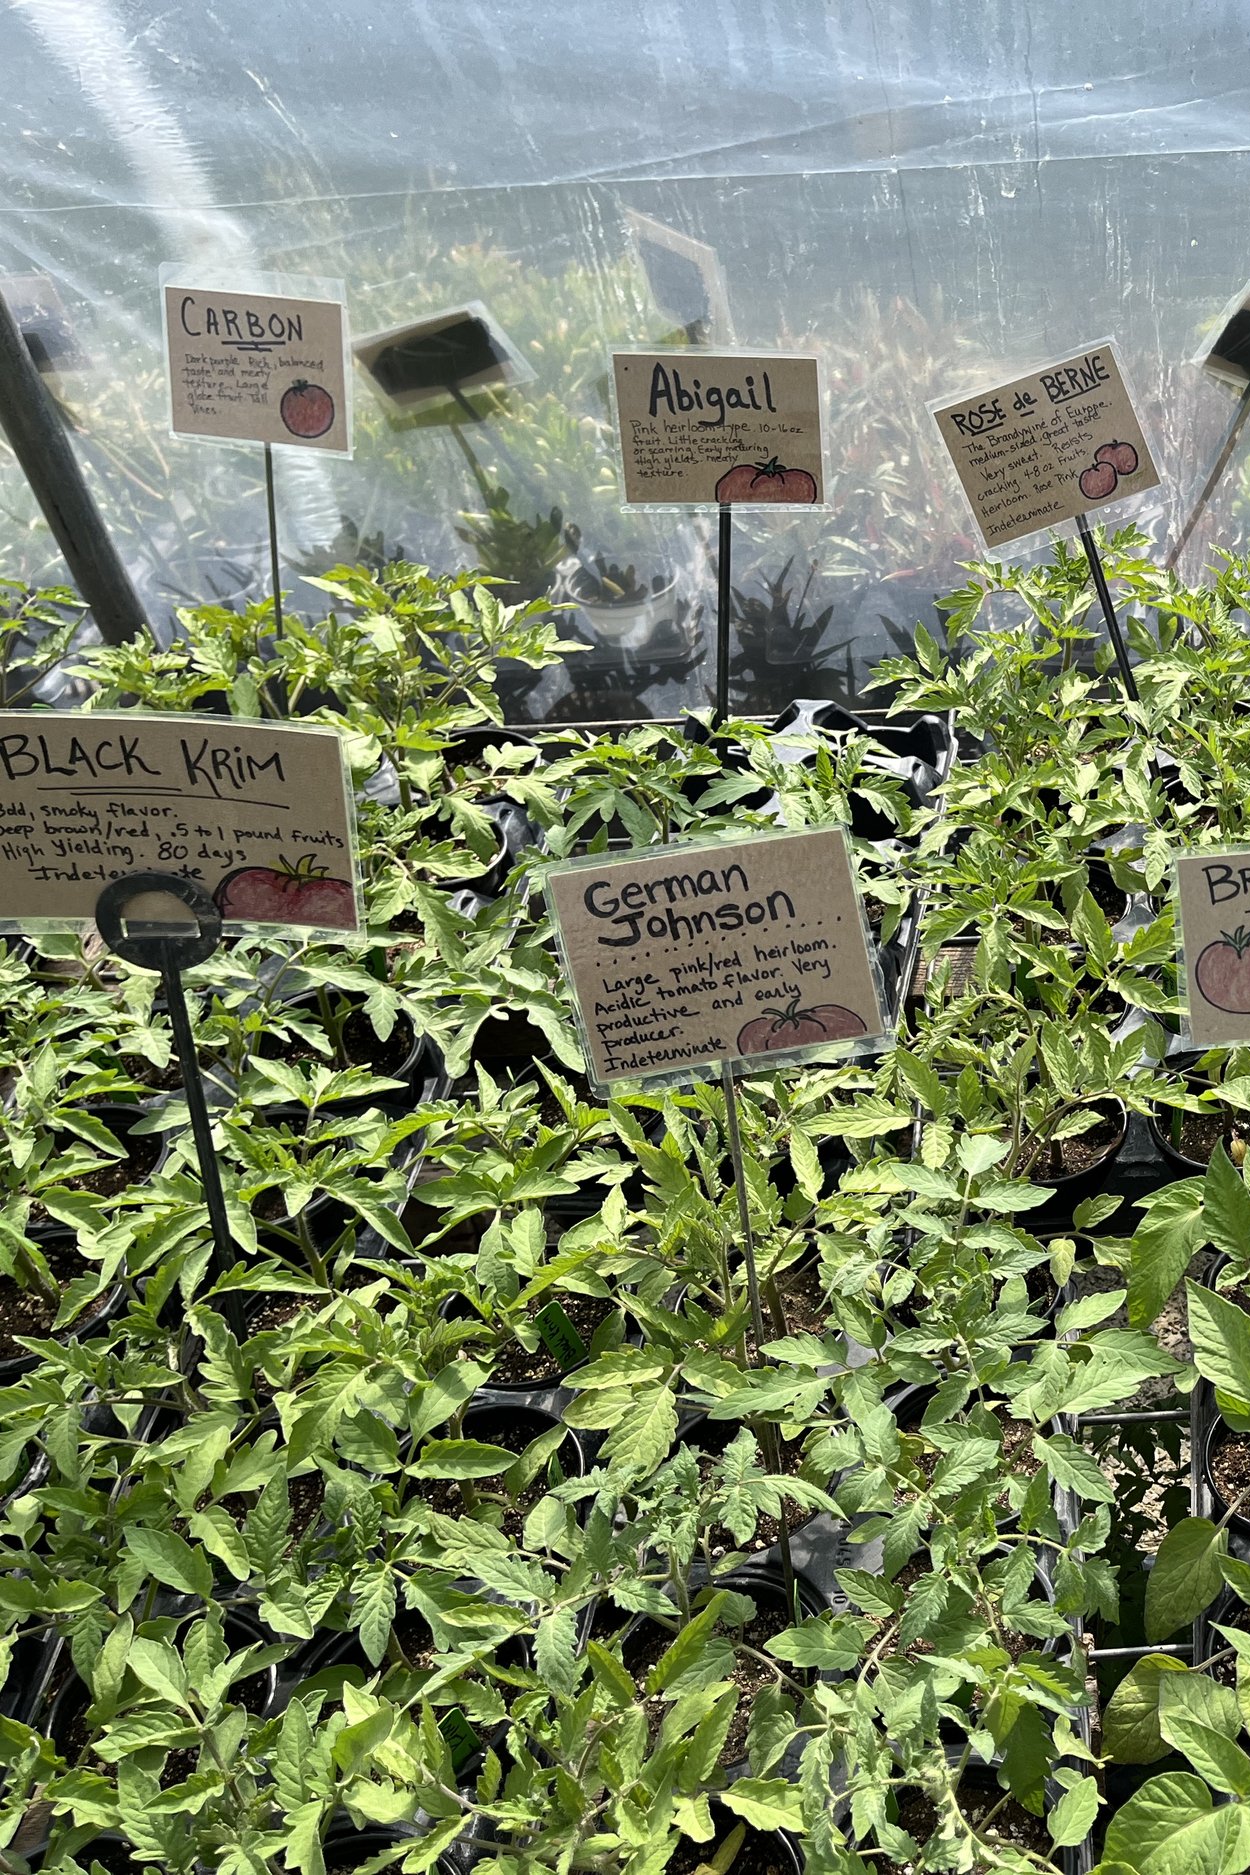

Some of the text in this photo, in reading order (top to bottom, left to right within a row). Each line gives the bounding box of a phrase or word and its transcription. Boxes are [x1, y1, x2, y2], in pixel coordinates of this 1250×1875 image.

[181, 296, 303, 342] CARBON
[218, 368, 235, 376] and
[649, 361, 777, 427] Abigail
[950, 355, 1110, 436] ROSE de BERNE
[629, 419, 658, 434] Pink
[962, 401, 1113, 454] The Brandywine of Europe.
[1072, 413, 1101, 427] taste
[668, 435, 698, 445] Little
[700, 434, 743, 445] cracking
[698, 445, 723, 457] Early
[726, 442, 768, 459] maturing
[980, 431, 1093, 481] Very sweet. Resists
[1023, 465, 1041, 479] 4-8
[1043, 463, 1055, 472] oz
[1033, 480, 1053, 494] Rose
[1054, 468, 1079, 486] Pink
[986, 500, 1065, 536] Indeterminate
[0, 733, 287, 798] BLACK KRIM
[40, 801, 100, 827] smoky
[194, 825, 213, 837] to
[233, 826, 283, 844] pound
[1, 842, 46, 867] High
[158, 841, 189, 861] 80
[197, 843, 248, 868] days
[583, 864, 750, 918] German
[597, 890, 795, 947] Johnson
[603, 939, 837, 995] Large pink/red heirloom.
[594, 993, 651, 1016] Acidic
[656, 979, 718, 1000] tomato
[792, 958, 832, 979] Very
[597, 982, 802, 1039] productive and early
[601, 1026, 684, 1056] producer.
[604, 1036, 727, 1073] Indeterminate
